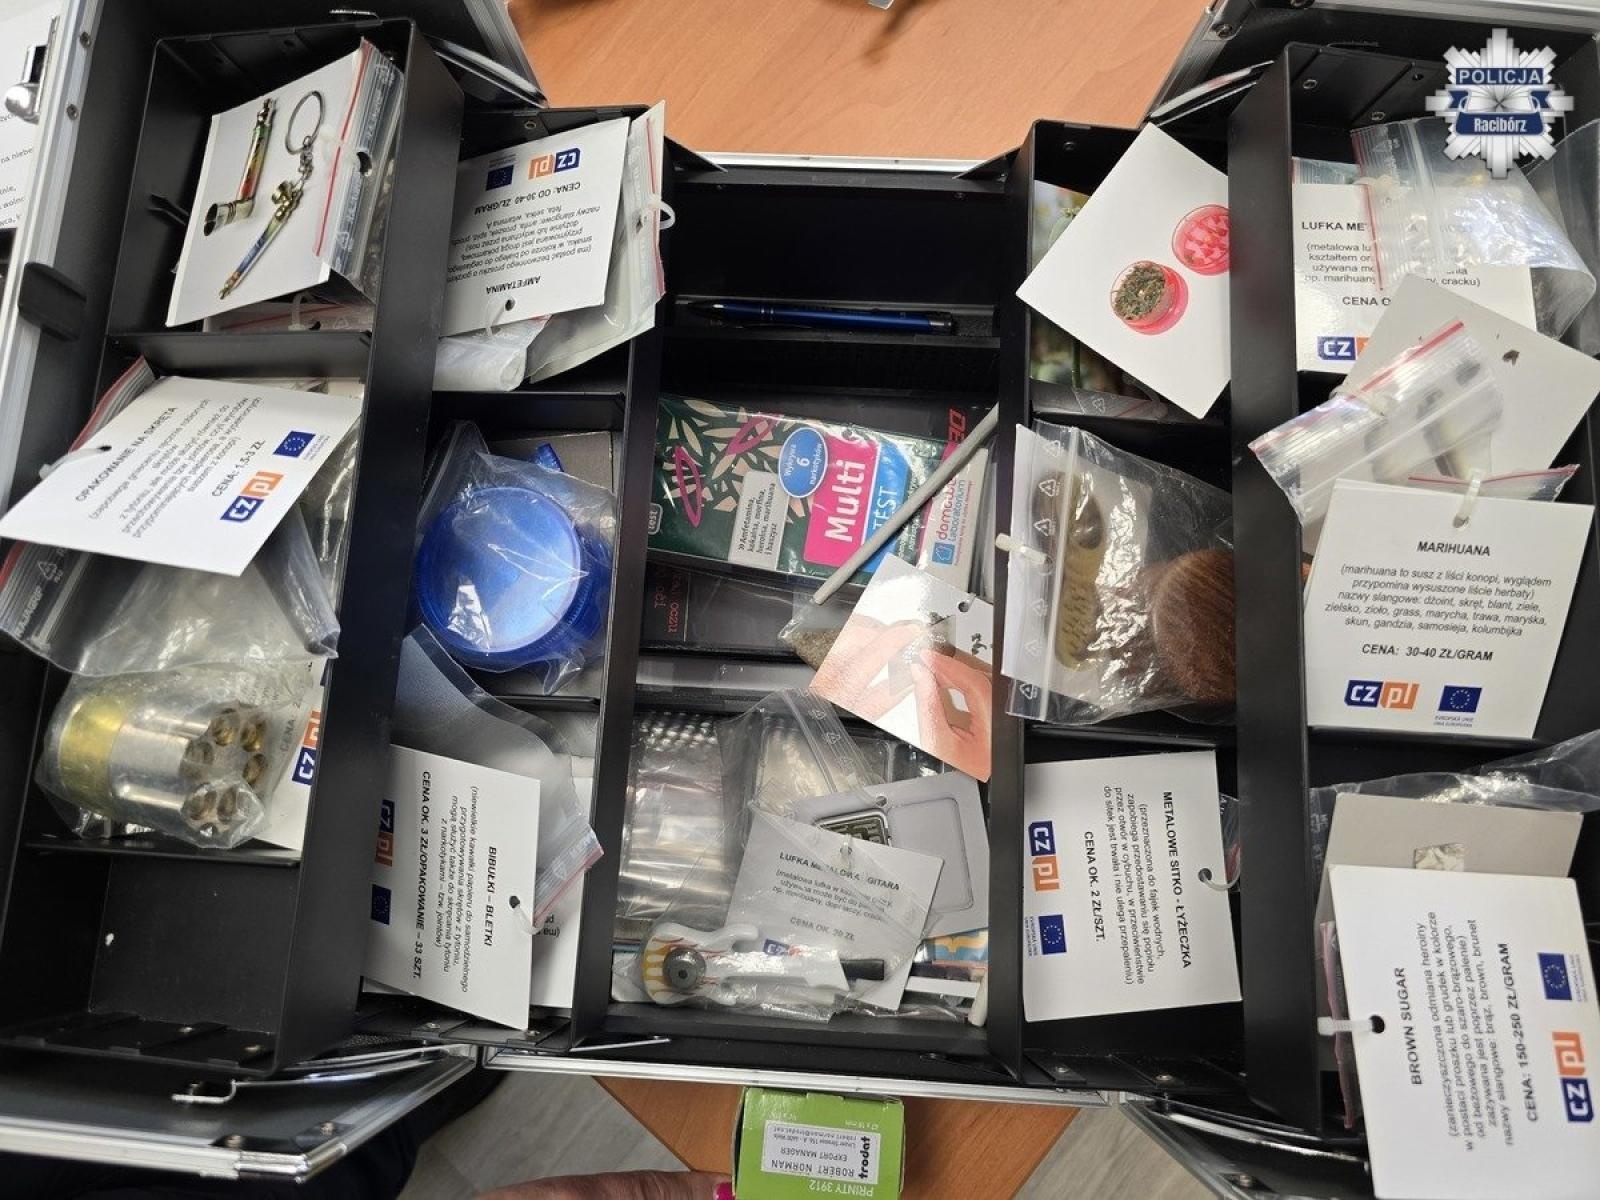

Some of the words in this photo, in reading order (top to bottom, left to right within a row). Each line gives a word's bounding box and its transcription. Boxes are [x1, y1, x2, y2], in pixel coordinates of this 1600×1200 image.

[553, 181, 580, 193] CENA:
[1301, 221, 1342, 230] LUFKA
[1306, 243, 1359, 253] (metalowa
[1308, 253, 1357, 262] kształtem
[1312, 264, 1358, 273] używana
[485, 276, 540, 294] AMFETAMINA
[1441, 277, 1480, 287] cracku)
[1342, 296, 1378, 306] CENA
[75, 447, 136, 501] OPAKOWANIE
[131, 436, 146, 447] NA
[143, 406, 178, 435] SKRĘTA
[795, 456, 810, 467] 6
[763, 483, 776, 521] marihuana
[823, 458, 867, 543] Multi
[1417, 541, 1489, 555] MARIHUANA
[1341, 564, 1397, 576] (marihuana
[1399, 567, 1410, 578] to
[1410, 569, 1435, 579] susz
[1435, 571, 1443, 580] z
[1444, 570, 1464, 580] liści
[1465, 572, 1500, 584] konopi,
[1503, 576, 1551, 586] wyglądem
[1352, 579, 1410, 590] przypomina
[1411, 582, 1465, 593] wysuszone
[1467, 585, 1492, 596] liście
[1494, 587, 1534, 600] herbaty)
[1324, 602, 1361, 614] zielsko,
[1364, 604, 1391, 616] zioło,
[1392, 607, 1423, 617] grass,
[1425, 609, 1470, 621] marycha,
[1472, 611, 1500, 622] trawa,
[1504, 615, 1546, 625] maryśka,
[1337, 591, 1370, 601] nazwy
[1372, 592, 1421, 604] slangowe:
[1423, 595, 1455, 607] dżoint,
[1457, 598, 1484, 609] skręt,
[1487, 599, 1513, 611] blant,
[1515, 602, 1540, 613] ziele,
[1344, 615, 1370, 627] skun,
[1373, 619, 1414, 630] gandzia,
[1417, 622, 1468, 634] samosieja,
[1471, 624, 1522, 636] kolumbijka
[1361, 643, 1398, 655] CENA:
[1405, 646, 1436, 657] 30-40
[1439, 648, 1492, 660] ZŁ/GRAM
[1126, 793, 1139, 842] zapobiega
[1163, 791, 1178, 856] METALOWE
[1084, 831, 1096, 864] CENA
[1138, 803, 1153, 872] (przeznaczona
[487, 846, 496, 893] BIBUŁKI
[778, 851, 810, 867] LUFKA
[1088, 866, 1098, 887] OK.
[1131, 843, 1148, 918] przedostawaniu
[1146, 874, 1157, 887] do
[1170, 860, 1182, 895] SITKO
[1148, 888, 1159, 912] fajek
[484, 904, 493, 946] BLETKI
[1091, 899, 1105, 941] ZŁ/SZT.
[1140, 920, 1150, 936] się
[1152, 914, 1164, 959] wodnych,
[1175, 905, 1191, 967] ŁYŻECZKA
[1415, 923, 1430, 966] heroiny
[1141, 936, 1155, 972] popiołu
[1497, 943, 1518, 1008] ZŁ/GRAM
[1394, 968, 1411, 1020] SUGAR
[1424, 969, 1440, 1021] odmiana
[1510, 1013, 1528, 1067] 150-250
[1404, 1026, 1421, 1084] BROWN
[1433, 1025, 1459, 1136] (zanieczyszczona
[1521, 1074, 1537, 1121] CENA:
[779, 1146, 817, 1158] MANAGER
[818, 1150, 848, 1161] EXPORT
[857, 1135, 871, 1180] trodat
[770, 1158, 813, 1172] NORMAN
[817, 1164, 854, 1177] ROBERT
[808, 1178, 833, 1192] 3912
[834, 1182, 874, 1197] PRINTY
